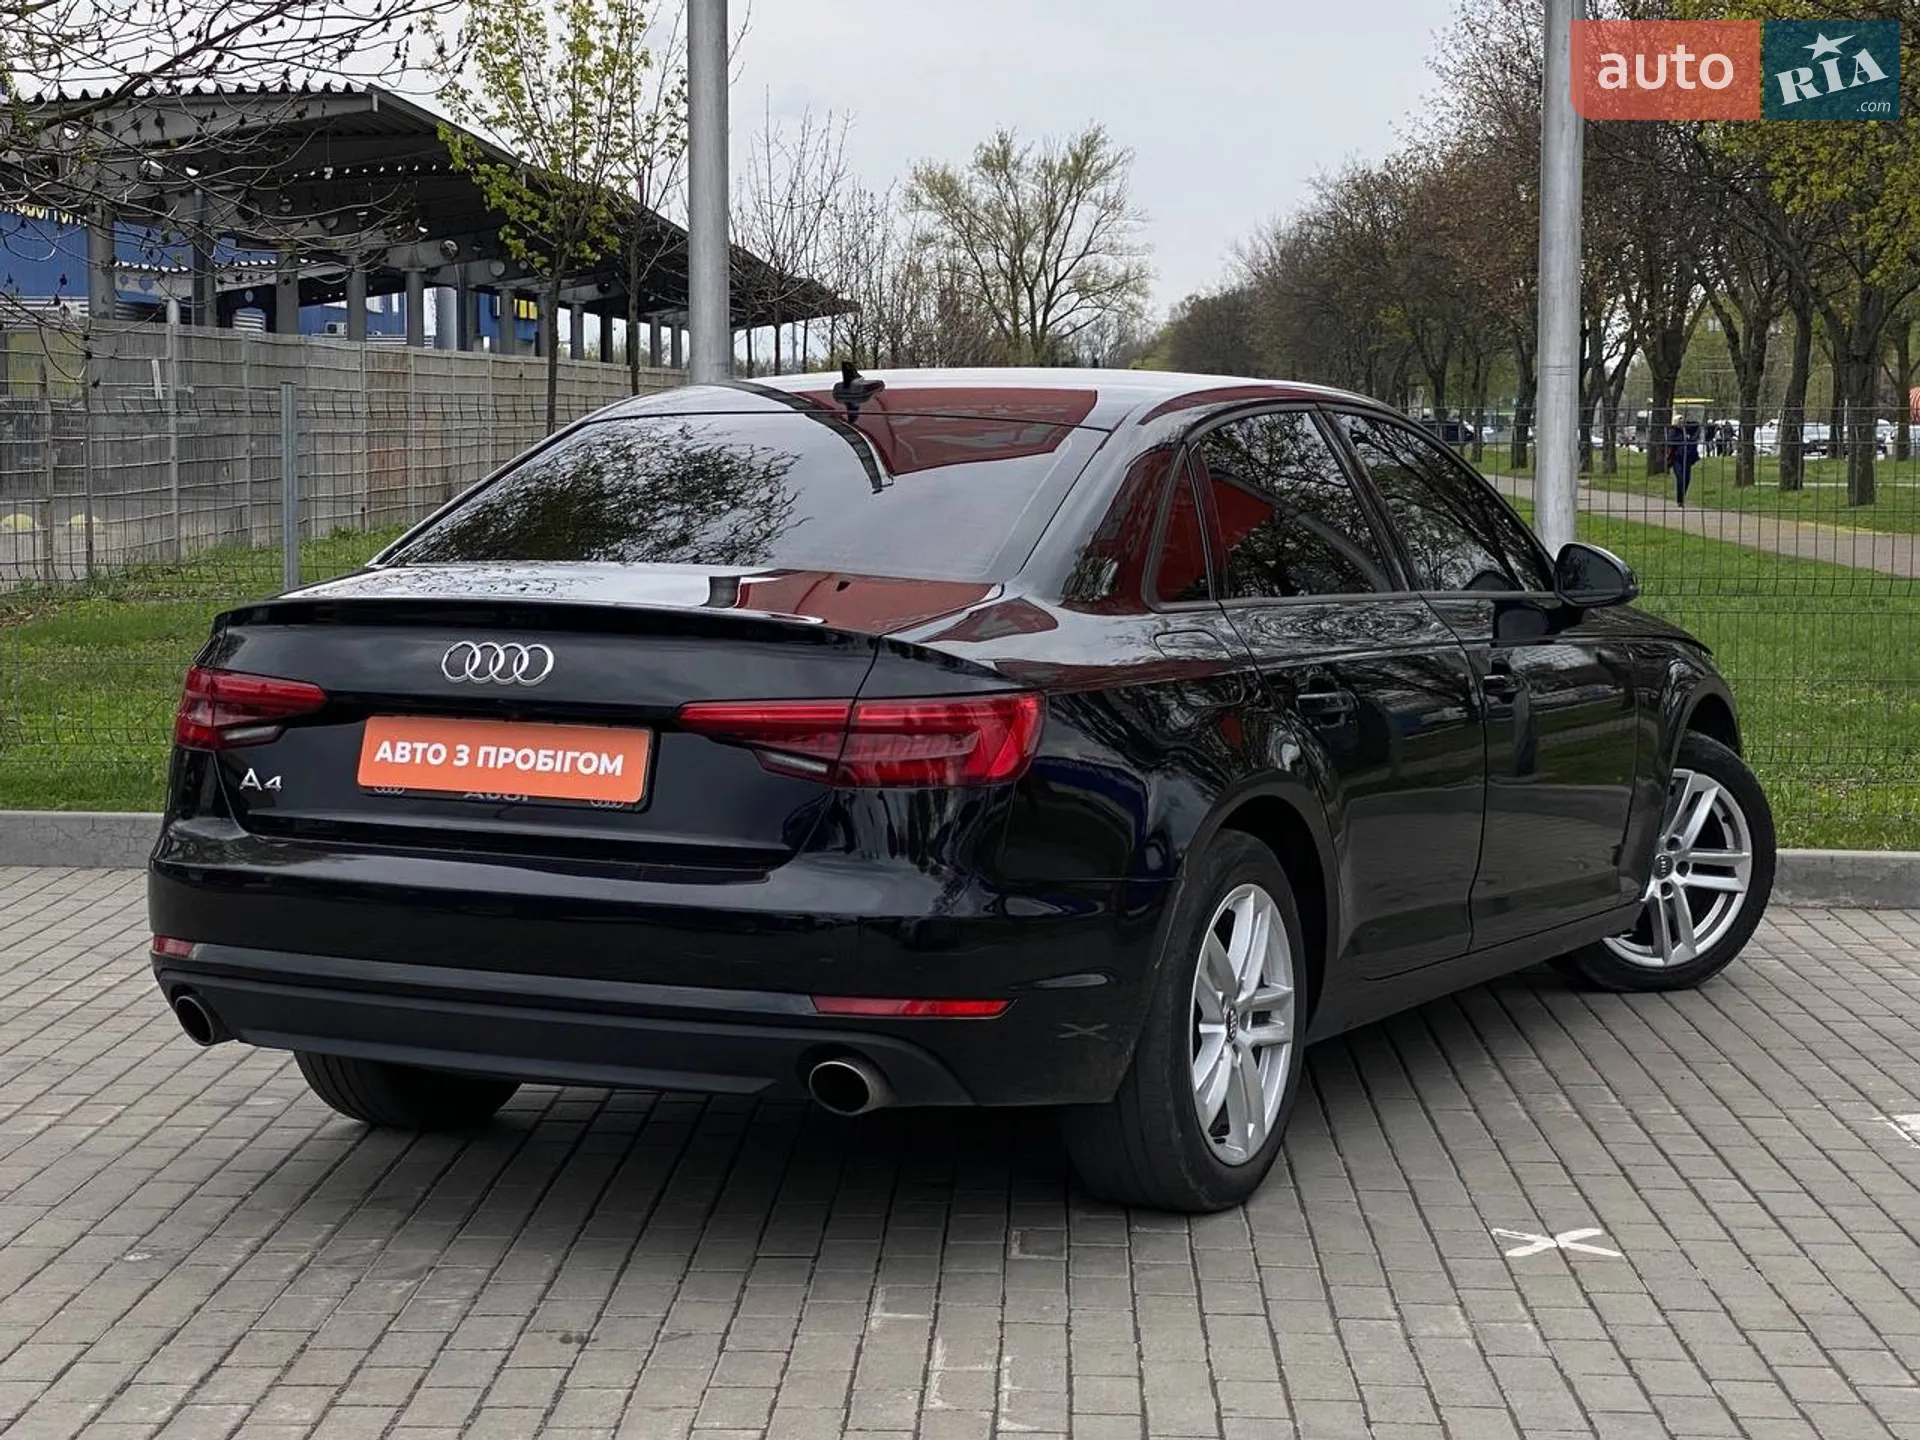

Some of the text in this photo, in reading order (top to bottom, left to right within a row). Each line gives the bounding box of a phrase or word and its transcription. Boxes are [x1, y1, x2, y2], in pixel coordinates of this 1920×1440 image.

[374, 740, 447, 765] АВТО
[476, 745, 624, 776] ПРОБІГОМ
[239, 768, 282, 792] A4
